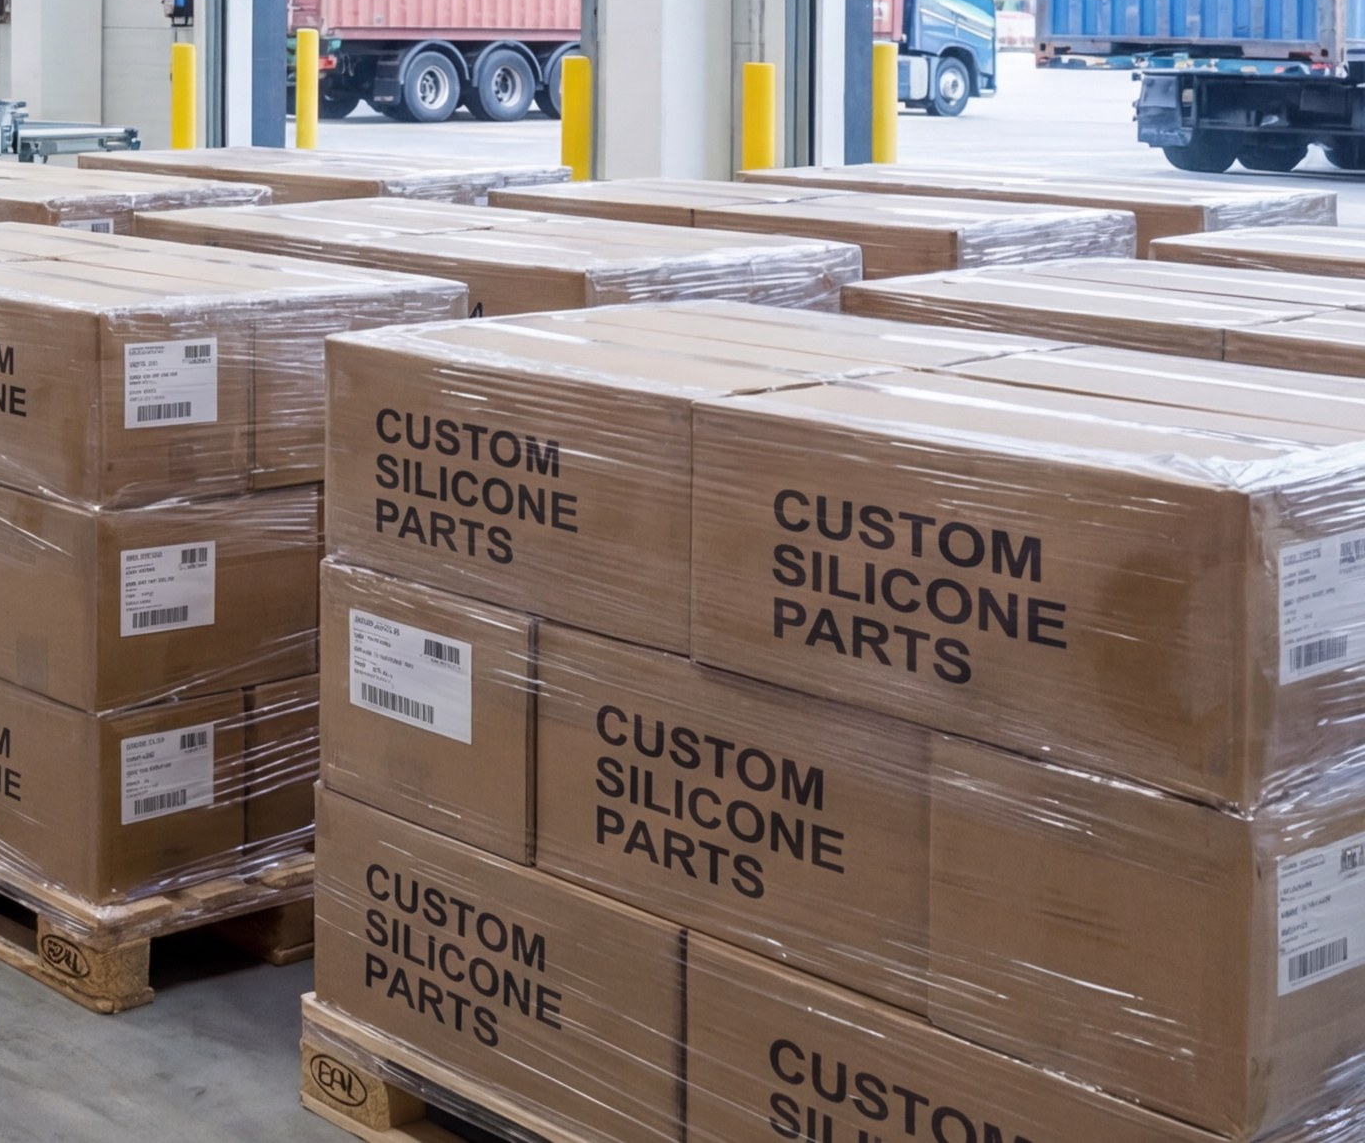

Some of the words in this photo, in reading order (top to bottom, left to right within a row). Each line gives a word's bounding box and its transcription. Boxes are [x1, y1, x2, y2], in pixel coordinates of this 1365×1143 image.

[376, 408, 559, 478] CUSTOM
[375, 454, 578, 533] SILICONE
[376, 498, 513, 564] PARTS
[773, 489, 1042, 583] CUSTOM
[772, 544, 1067, 649] SILICONE
[773, 597, 972, 684] PARTS
[596, 705, 824, 811] CUSTOM
[595, 756, 844, 874] SILICONE
[596, 805, 765, 899] PARTS
[366, 863, 545, 972] CUSTOM
[365, 909, 562, 1030] SILICONE
[365, 952, 499, 1047] PARTS
